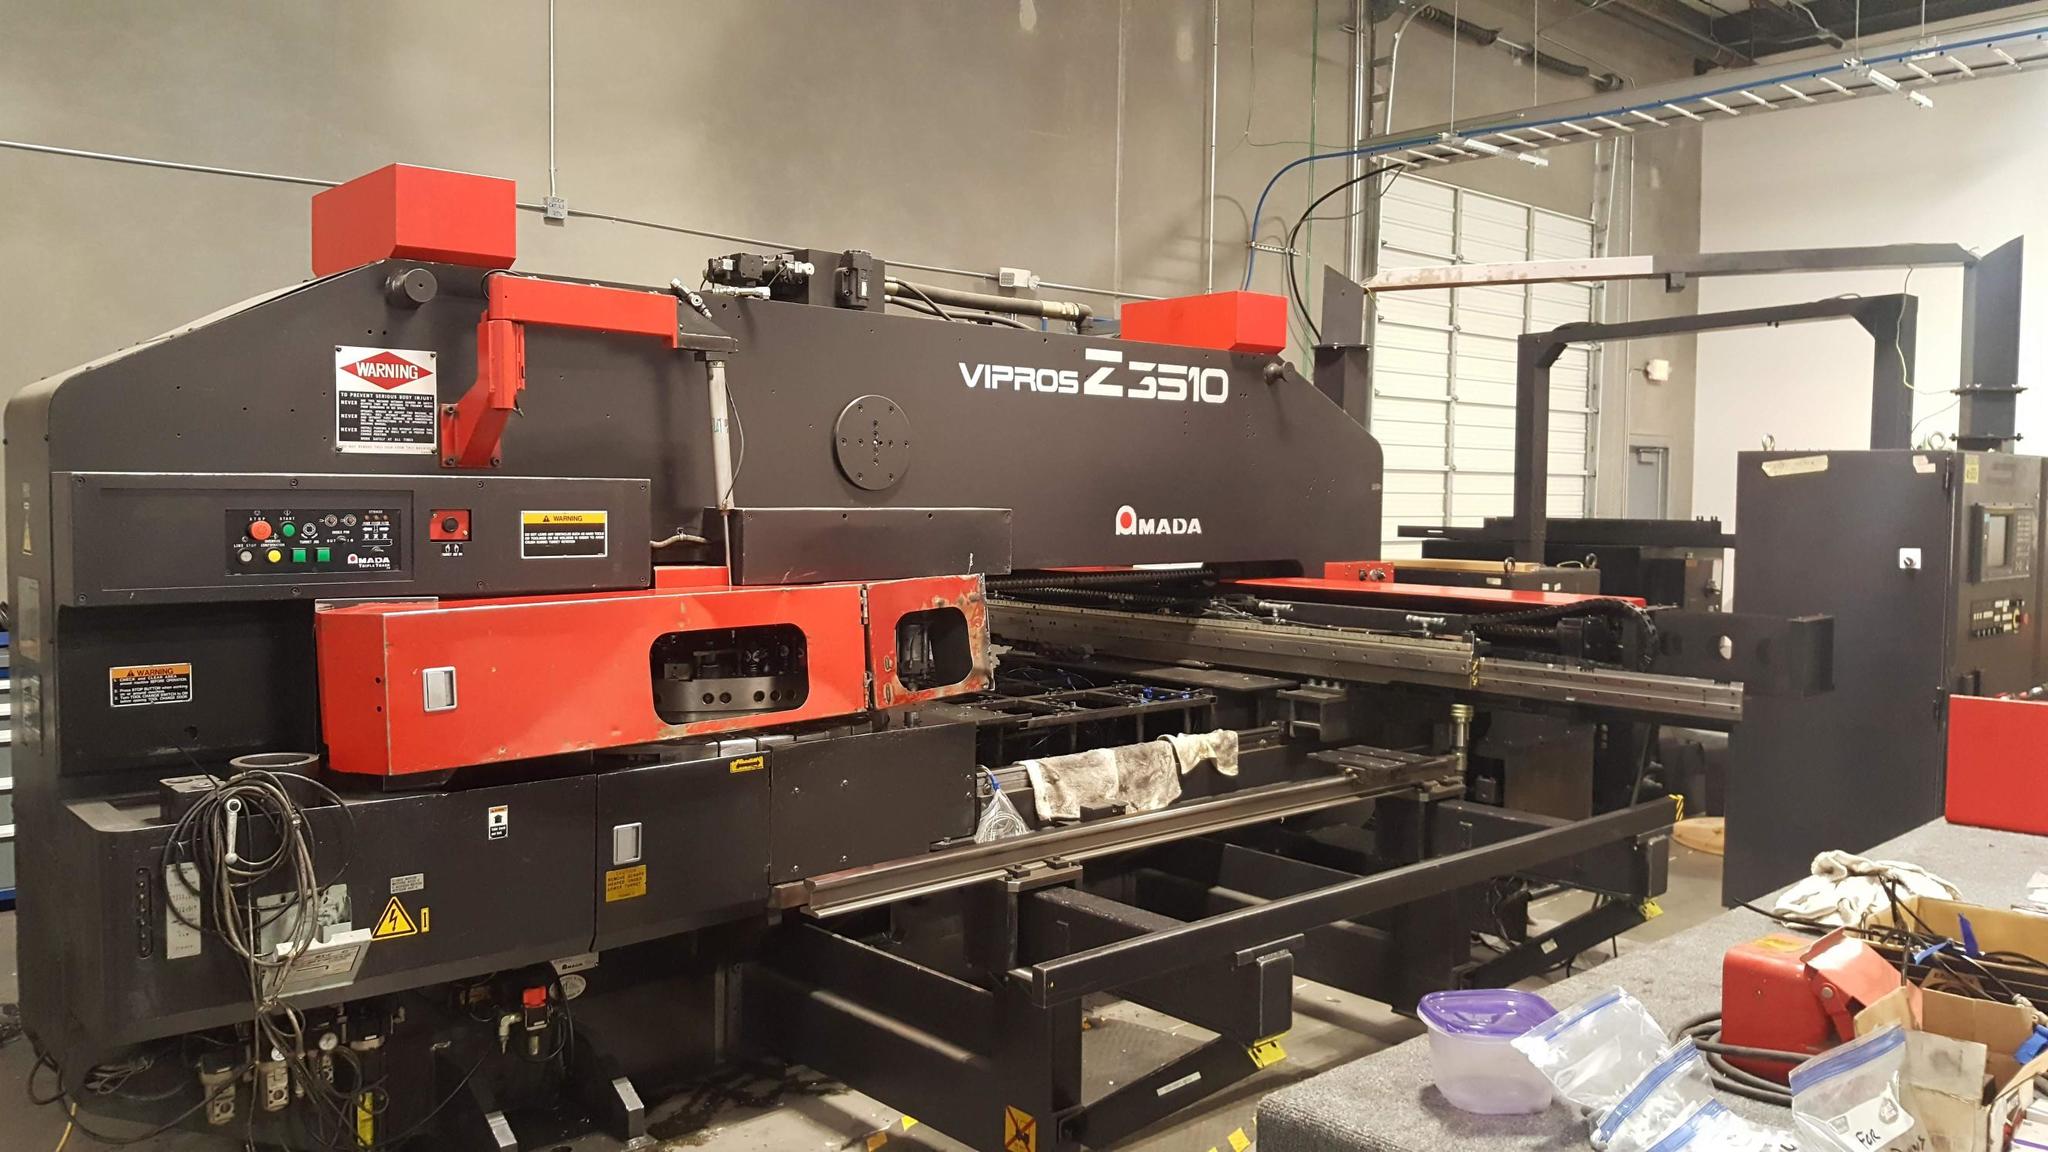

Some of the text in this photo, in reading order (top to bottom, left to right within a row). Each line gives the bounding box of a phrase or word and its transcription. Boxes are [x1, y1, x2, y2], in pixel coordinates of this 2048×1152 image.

[355, 362, 419, 379] WARNING
[958, 362, 1079, 394] VIPROS
[1115, 504, 1202, 535] AMADA
[347, 553, 390, 565] AMADA
[137, 667, 174, 676] WARNING
